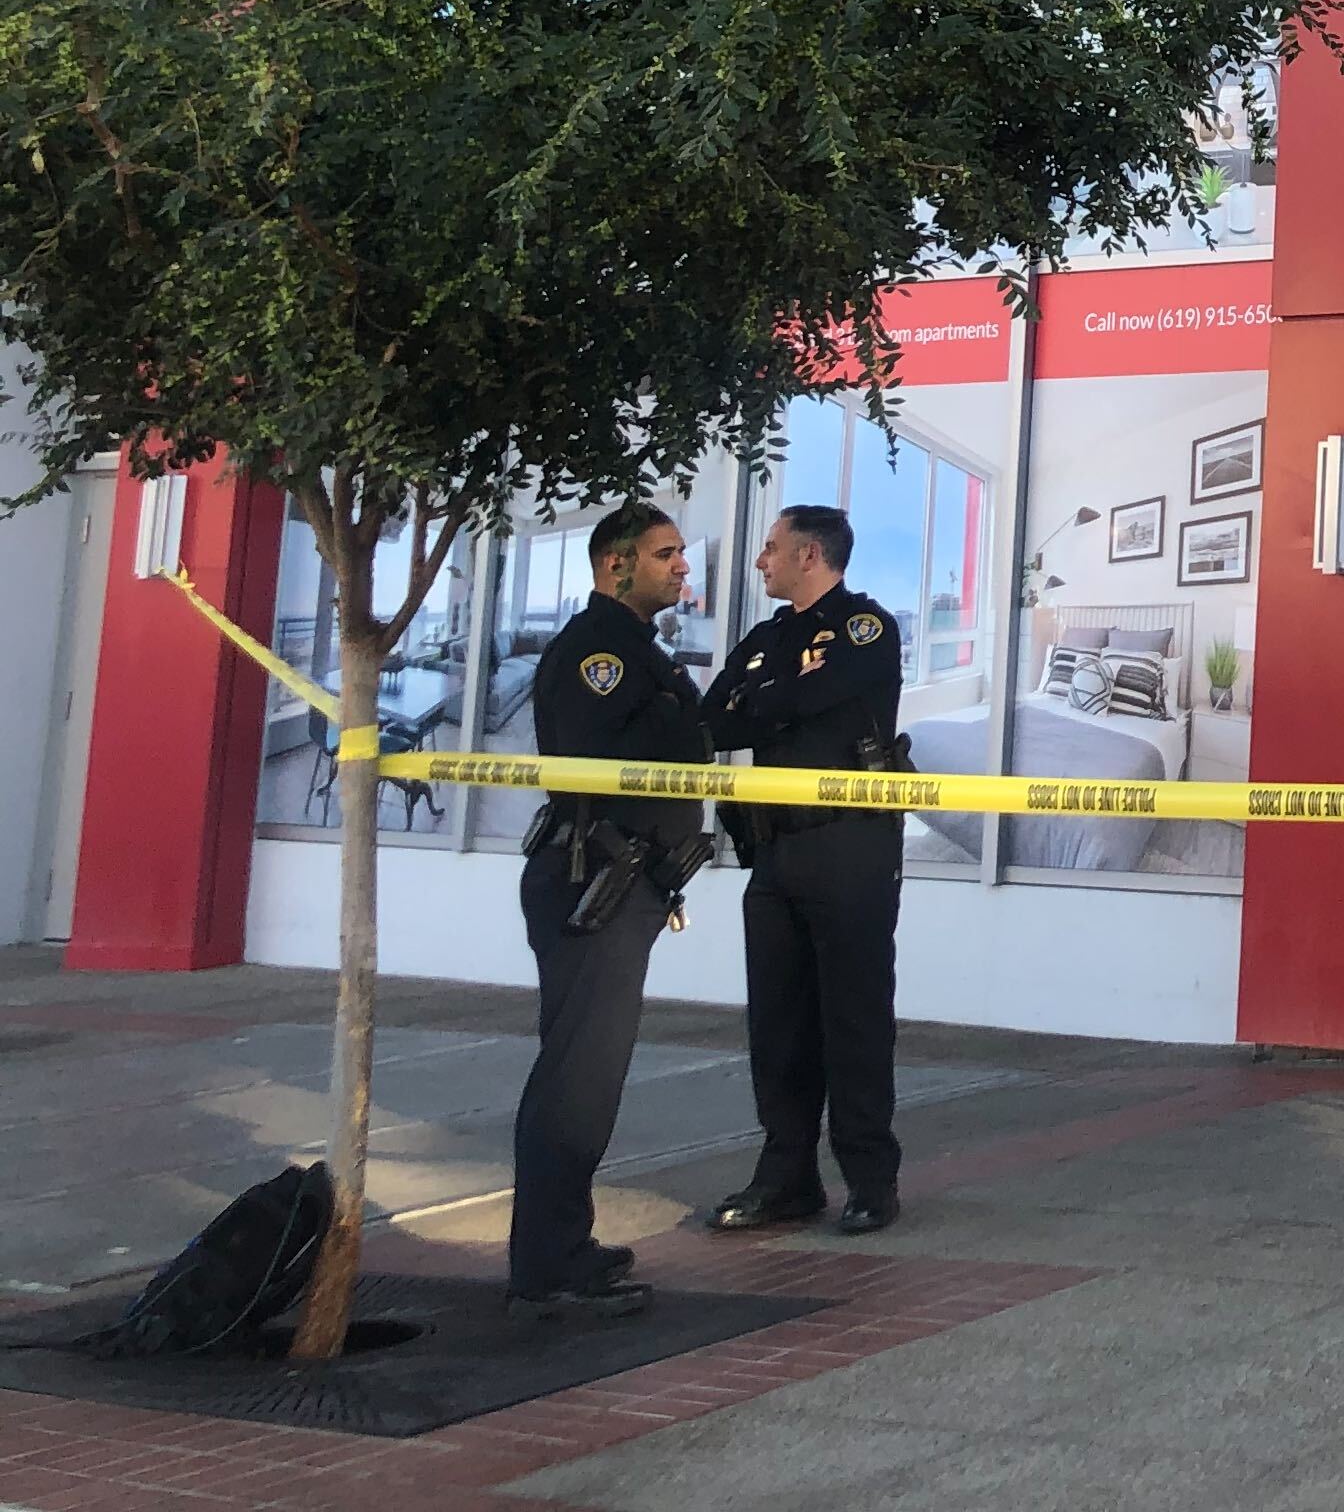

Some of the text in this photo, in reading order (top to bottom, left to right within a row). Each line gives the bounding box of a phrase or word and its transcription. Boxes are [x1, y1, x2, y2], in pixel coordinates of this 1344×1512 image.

[914, 320, 1000, 345] apartments
[1084, 309, 1116, 333] Call
[1119, 313, 1155, 331] now
[1158, 306, 1201, 332] (619)
[1061, 785, 1081, 811] NOT
[1083, 786, 1098, 811] DO
[1099, 786, 1121, 812] LINE
[1249, 790, 1282, 816] CROSS
[1285, 790, 1306, 816] NOT
[1308, 791, 1322, 817] DO
